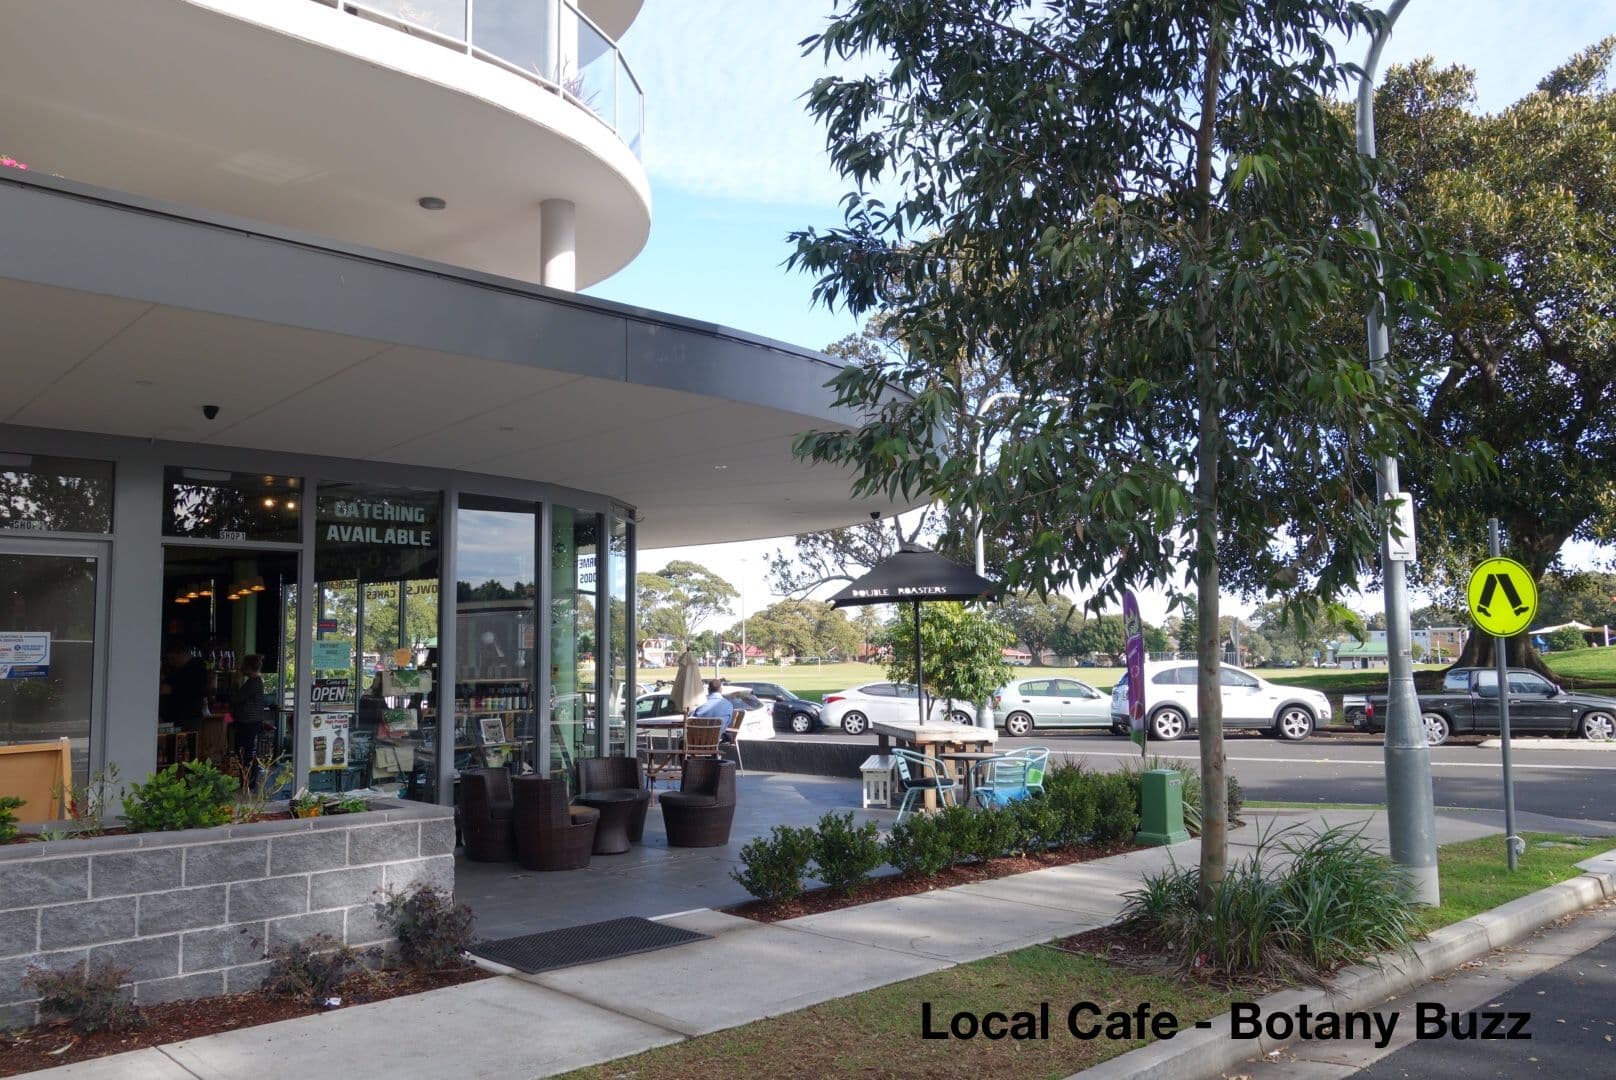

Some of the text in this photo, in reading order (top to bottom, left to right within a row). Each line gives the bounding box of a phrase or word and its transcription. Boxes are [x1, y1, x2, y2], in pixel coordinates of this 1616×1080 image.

[334, 500, 425, 523] CATERING
[219, 531, 240, 540] SHOP
[326, 524, 432, 547] AVAILABLE
[852, 586, 947, 597] DOUBLE ROASTERS
[312, 686, 346, 702] OPEN
